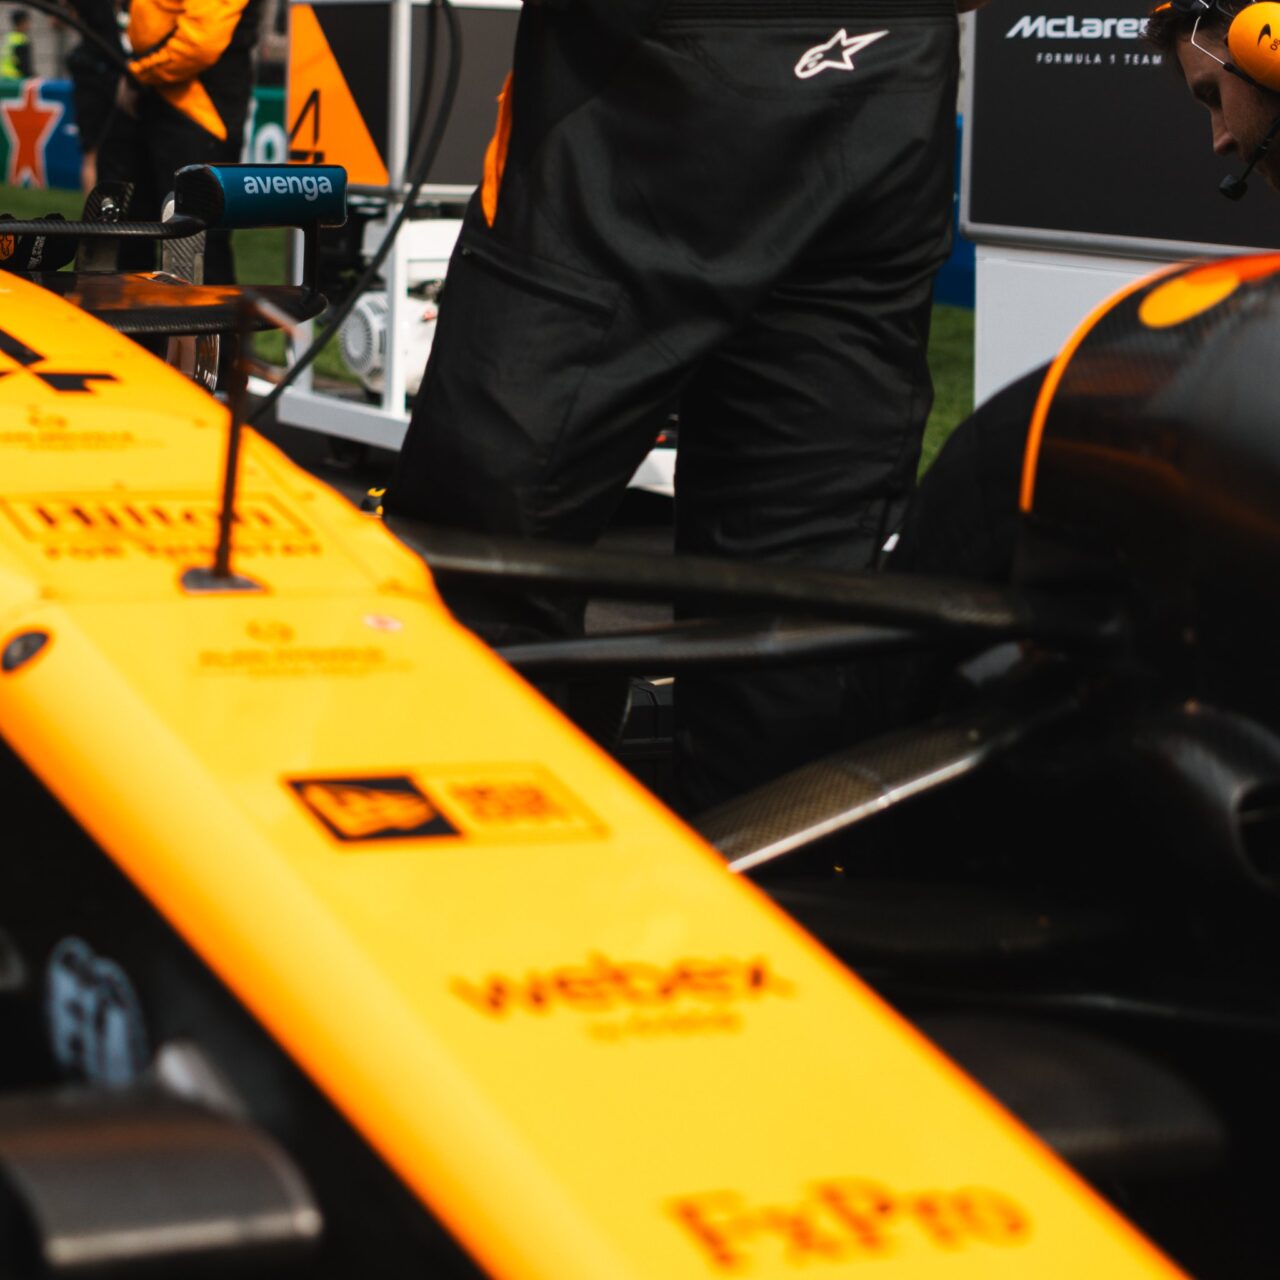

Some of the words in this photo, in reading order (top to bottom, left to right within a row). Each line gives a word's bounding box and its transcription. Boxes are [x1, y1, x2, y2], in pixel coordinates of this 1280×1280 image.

[1036, 52, 1102, 64] FORMULA
[1123, 53, 1163, 65] TEAM
[244, 175, 333, 201] avenga
